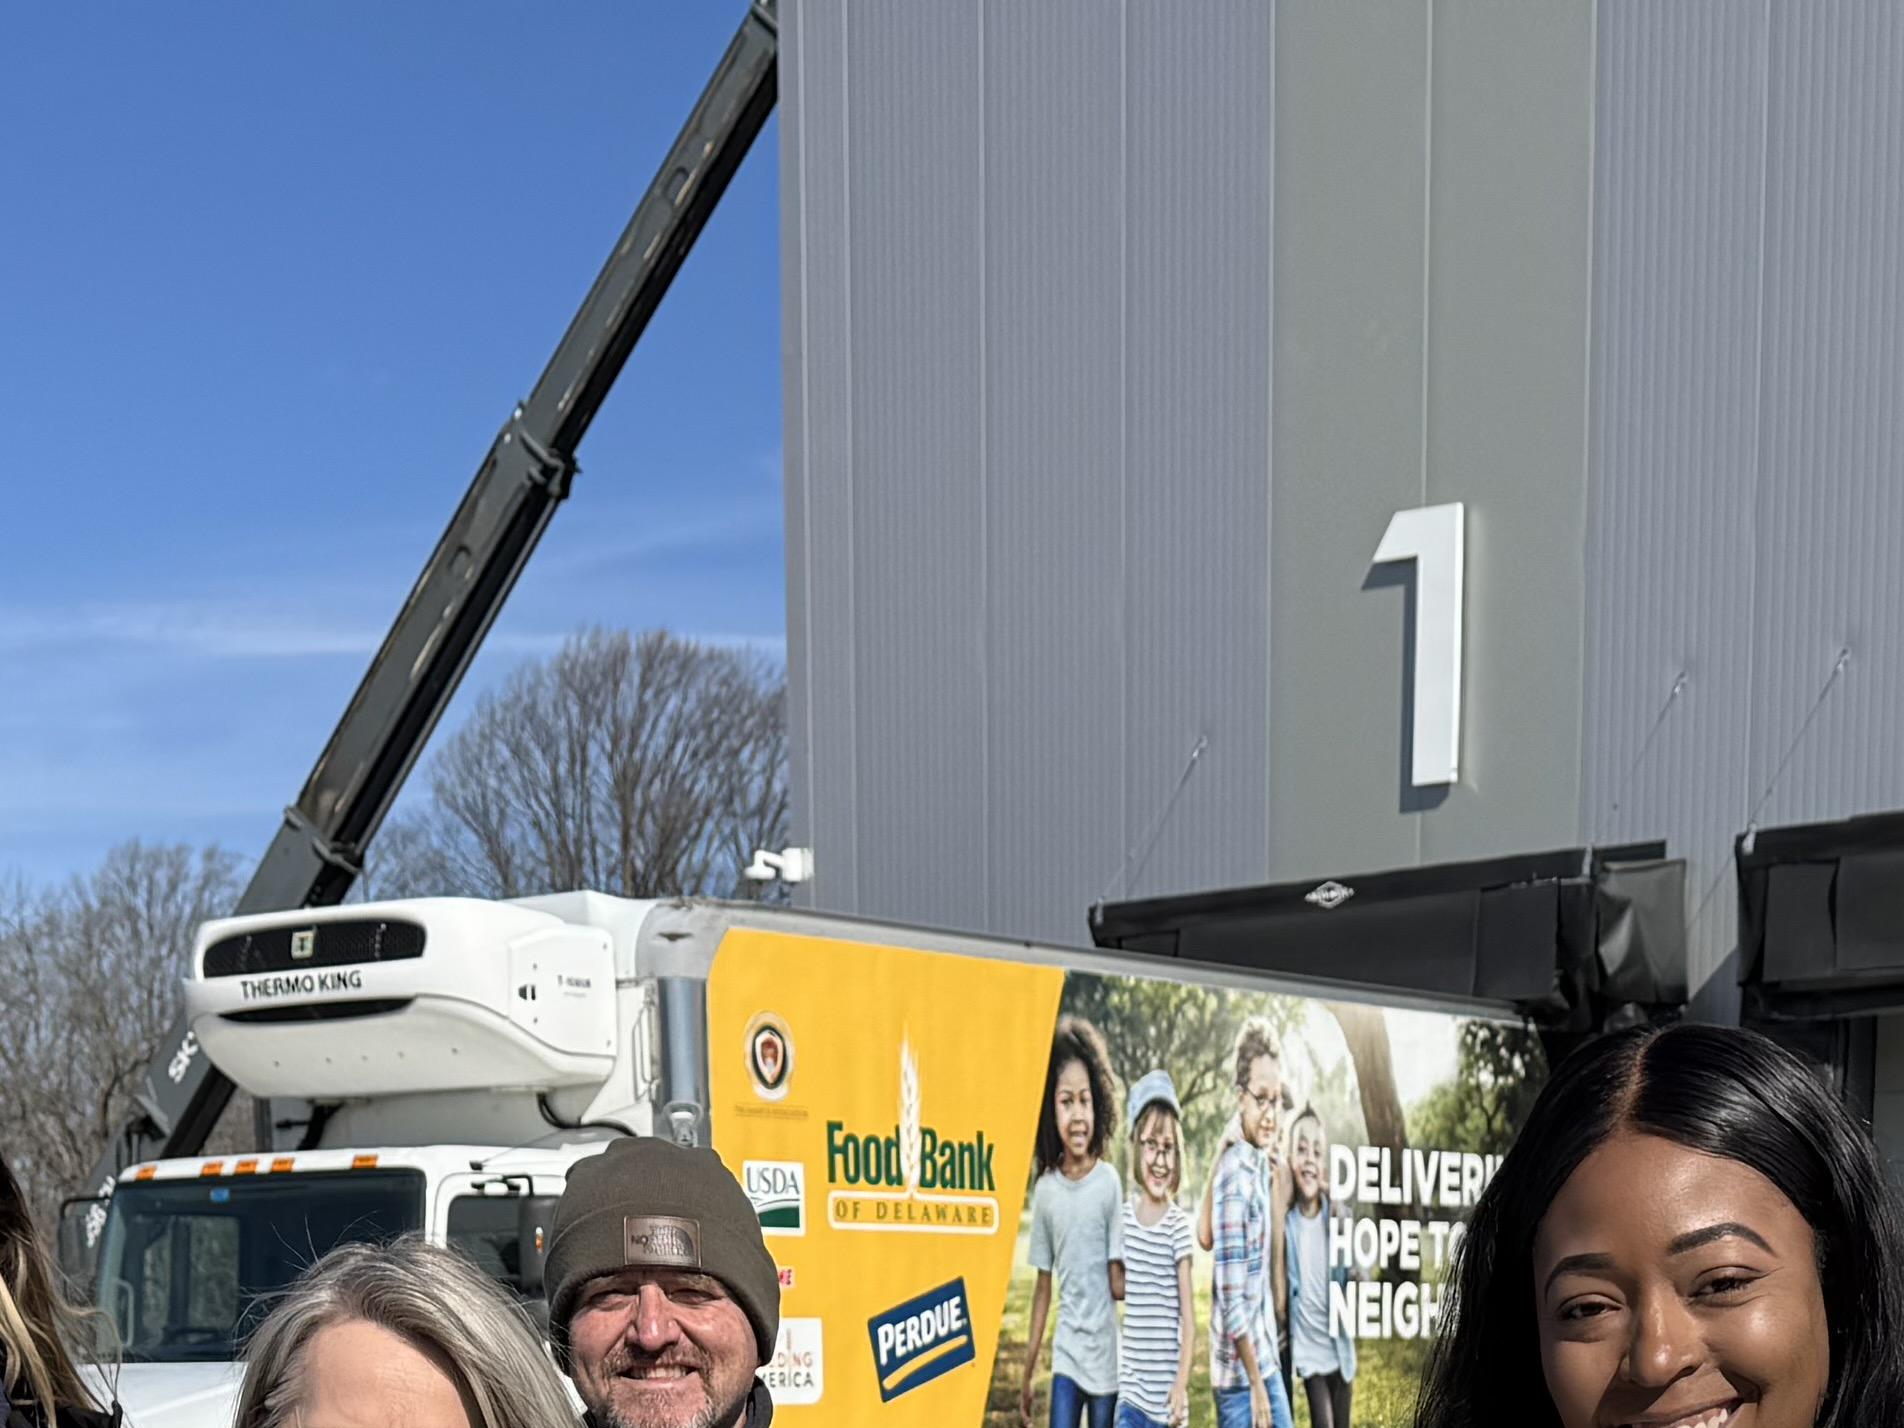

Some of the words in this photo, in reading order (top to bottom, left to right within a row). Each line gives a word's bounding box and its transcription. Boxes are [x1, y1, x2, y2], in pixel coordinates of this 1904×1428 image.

[1372, 501, 1464, 786] 1
[241, 975, 315, 1000] THERMO
[318, 970, 363, 990] KING
[168, 1030, 198, 1084] SK
[746, 1166, 800, 1195] USDA
[826, 1120, 903, 1186] Food
[919, 1126, 995, 1191] Bank
[835, 1200, 861, 1219] OF
[876, 1202, 994, 1224] DELAWARE
[1329, 1217, 1421, 1270] HOPE
[877, 1296, 962, 1366] PERDUE
